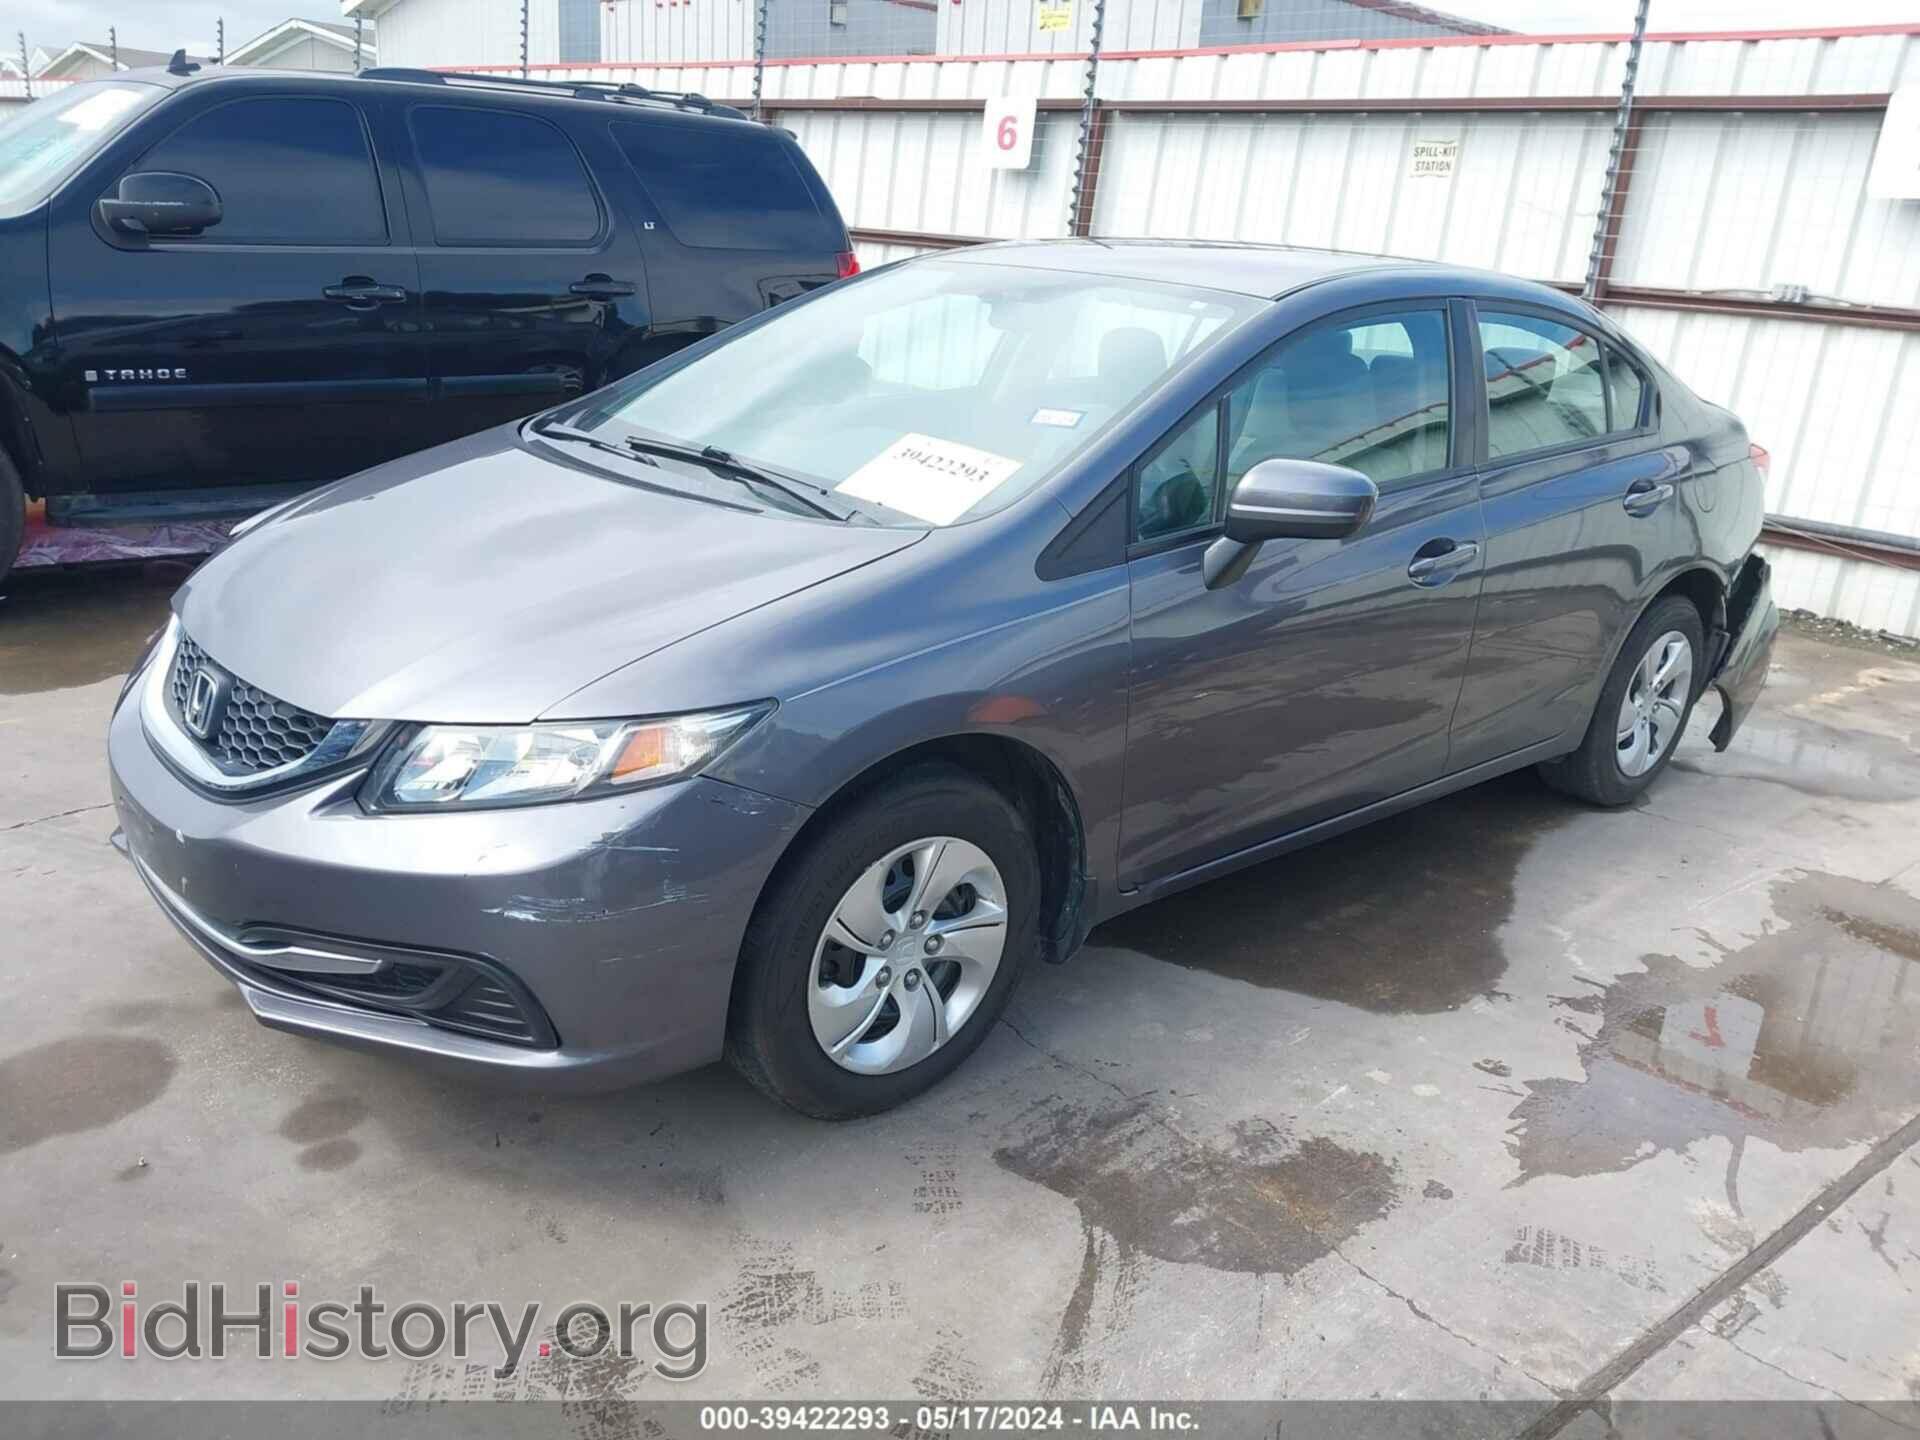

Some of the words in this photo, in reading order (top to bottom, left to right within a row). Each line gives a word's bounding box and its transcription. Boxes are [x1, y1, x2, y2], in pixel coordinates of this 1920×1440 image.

[997, 114, 1018, 151] 6
[1413, 145, 1457, 158] SPILL-KIT
[1415, 160, 1452, 173] STATION
[643, 221, 656, 230] LT
[104, 368, 187, 381] TAHOE
[892, 447, 990, 483] 39422293
